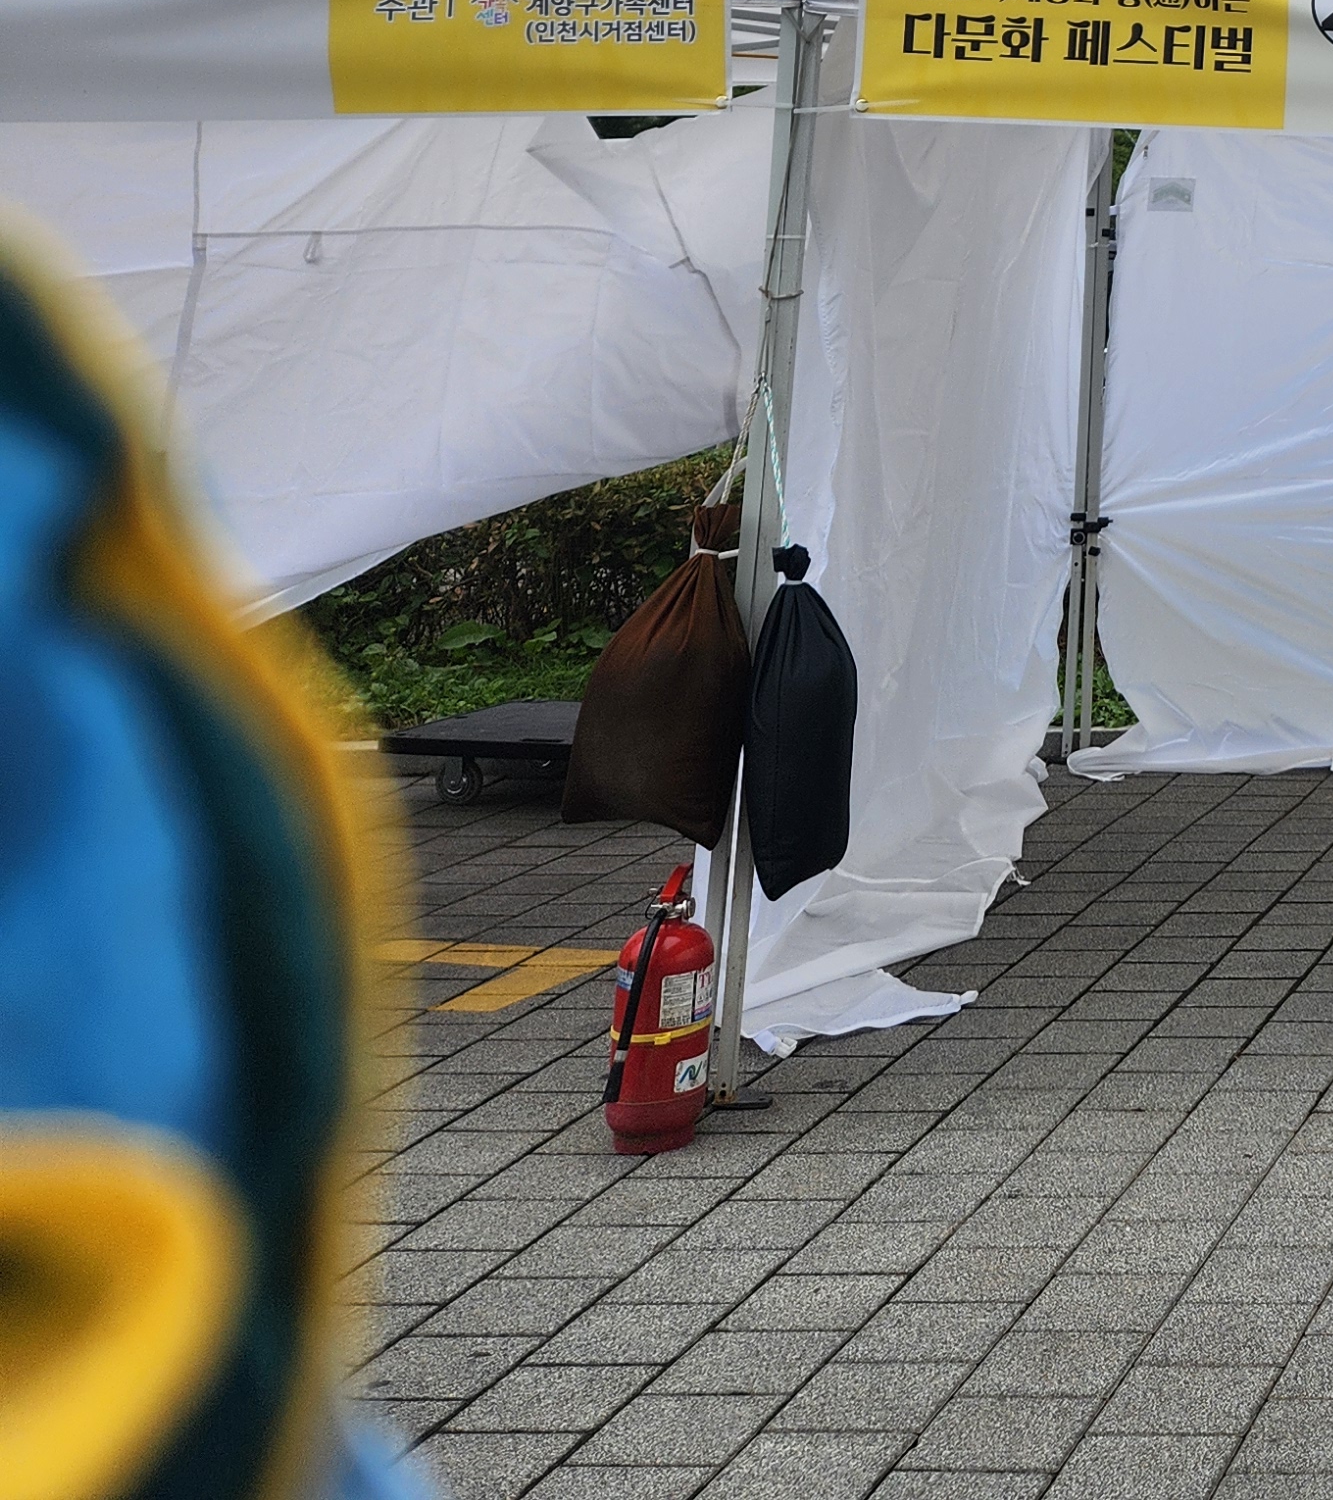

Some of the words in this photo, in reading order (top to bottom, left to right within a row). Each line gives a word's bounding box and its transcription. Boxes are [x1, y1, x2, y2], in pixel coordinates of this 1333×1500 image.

[526, 20, 696, 44] (인천시거점센터)
[902, 13, 1049, 63] 다문화
[1063, 20, 1253, 74] 페스티벌
